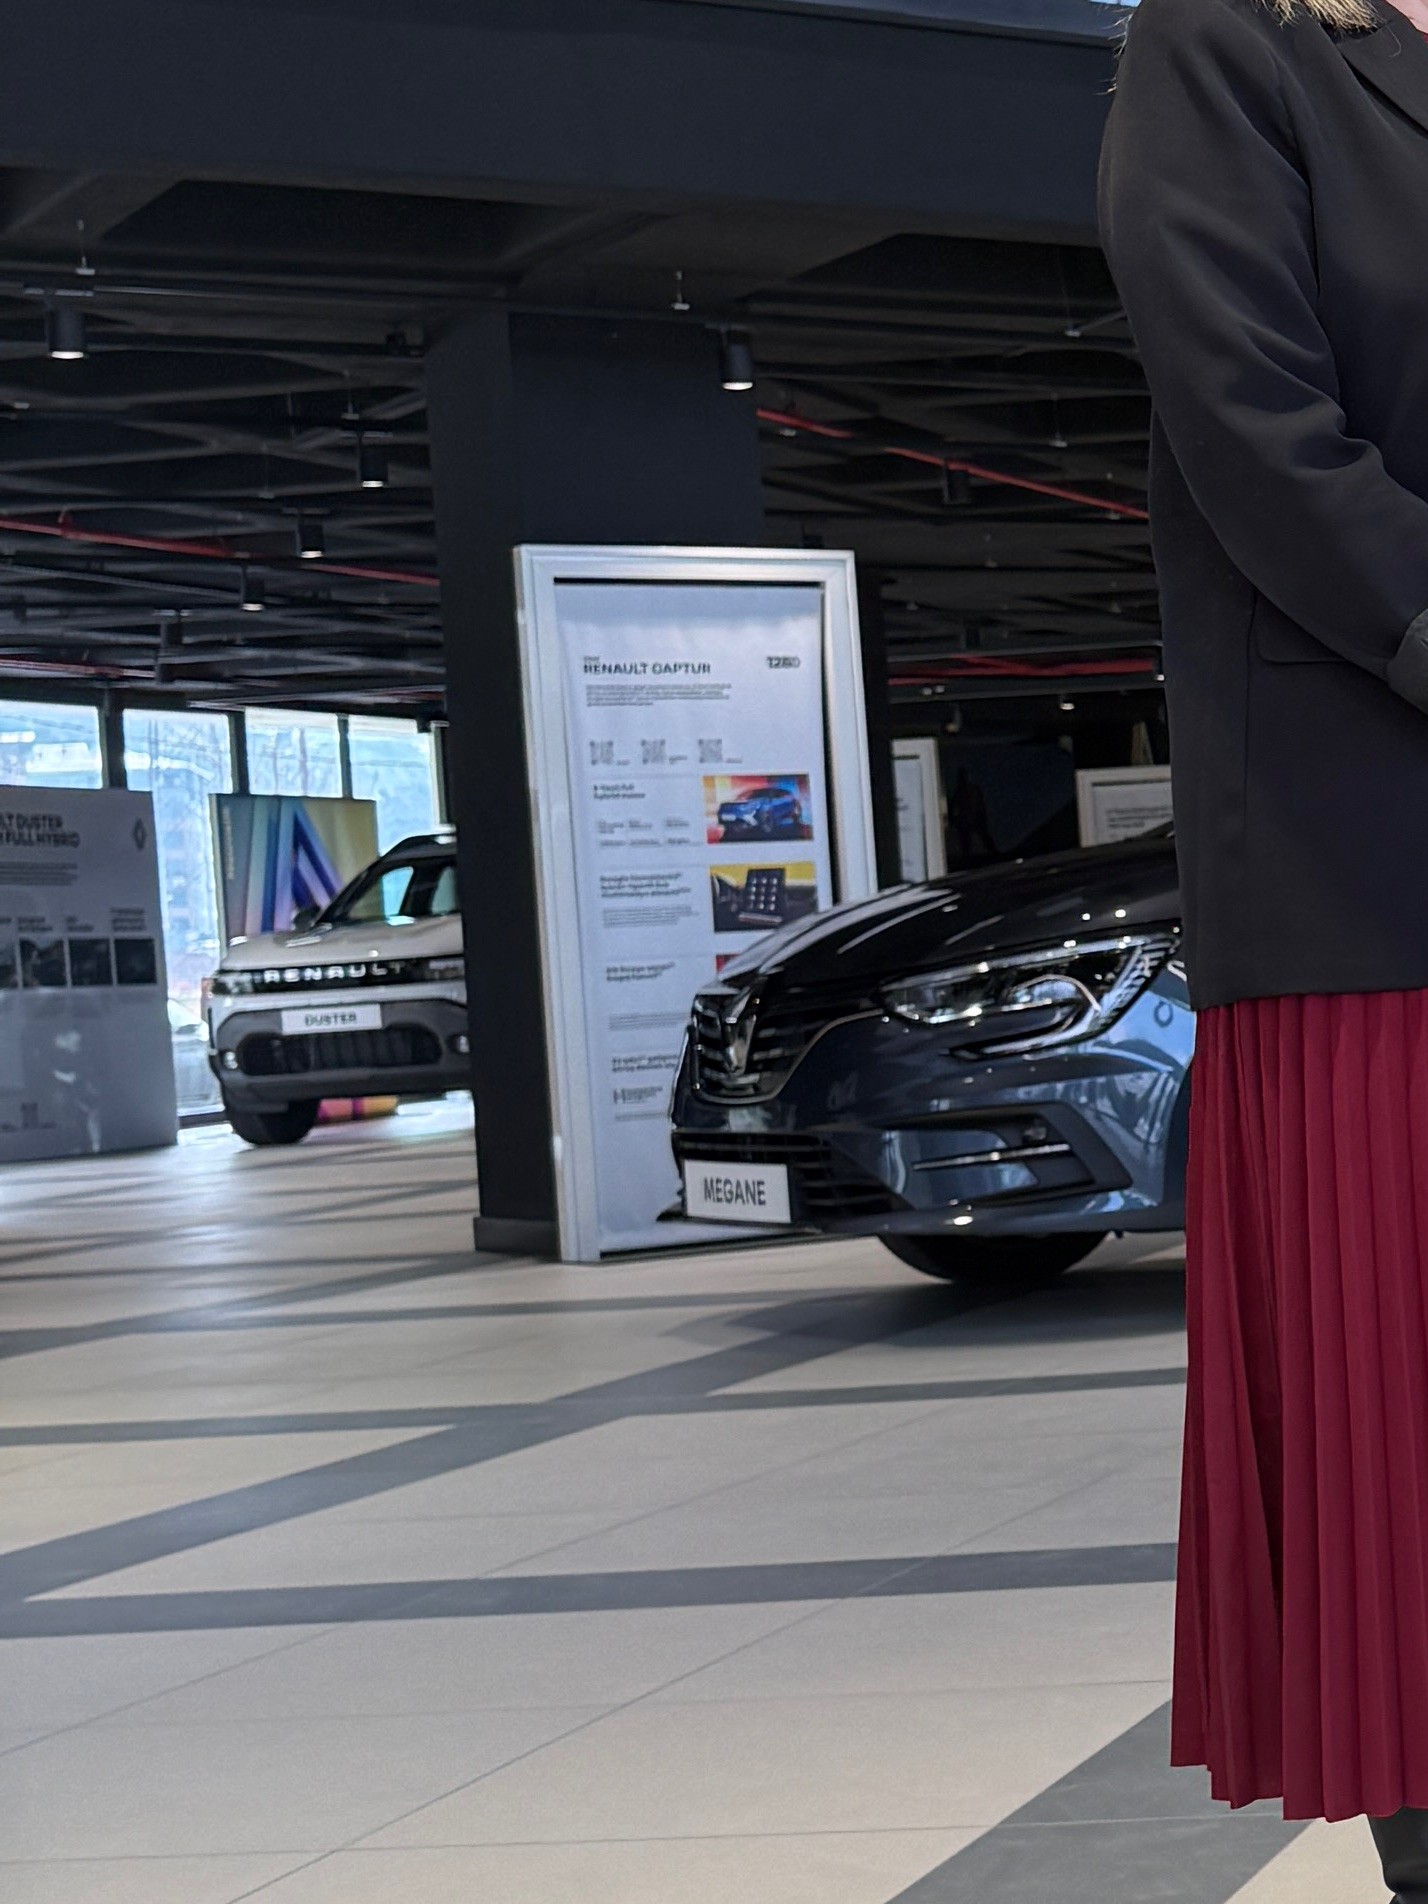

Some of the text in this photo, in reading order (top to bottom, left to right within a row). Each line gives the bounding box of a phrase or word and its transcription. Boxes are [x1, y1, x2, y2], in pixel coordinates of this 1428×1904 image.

[263, 961, 405, 983] RENAULT
[304, 1012, 357, 1027] DUSTER
[704, 1177, 766, 1206] MEGANE
